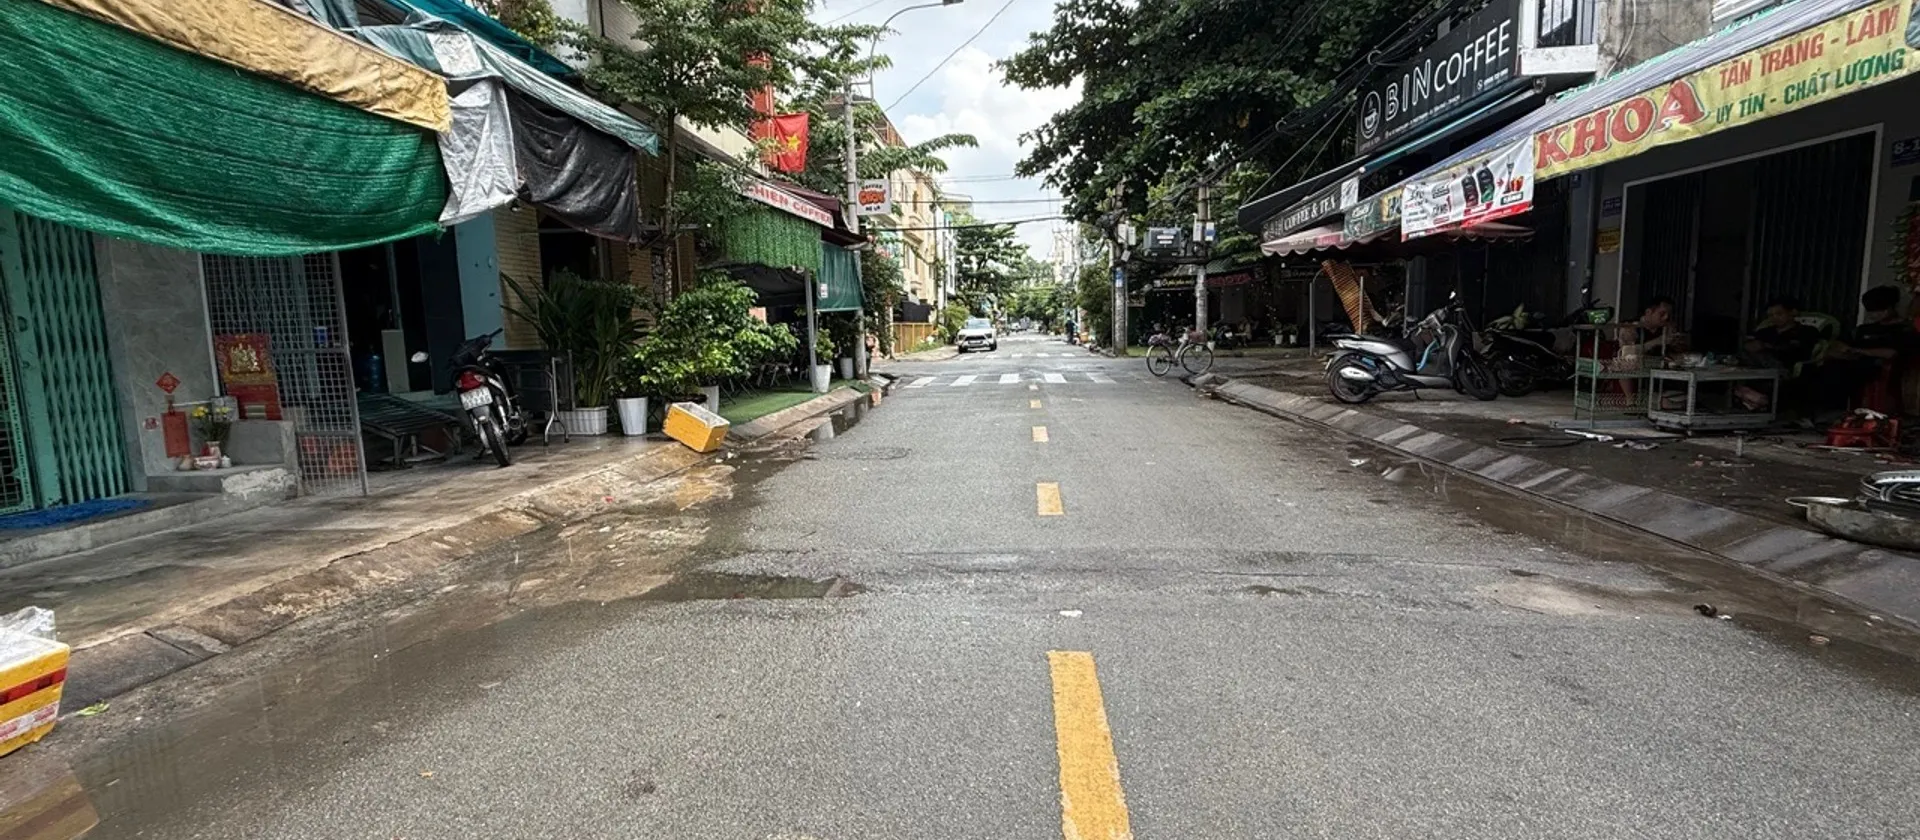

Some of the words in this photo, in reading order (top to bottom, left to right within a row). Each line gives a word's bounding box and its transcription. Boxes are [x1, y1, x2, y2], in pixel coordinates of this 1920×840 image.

[1385, 59, 1431, 122] BIN
[1434, 19, 1511, 92] COFFEE
[1716, 102, 1733, 124] UY
[1739, 93, 1766, 118] TÍN
[1784, 67, 1830, 105] CHẤT
[1835, 48, 1907, 88] LƯỢNG
[1719, 58, 1752, 90] TÂN
[1760, 32, 1825, 76] TRANG
[1846, 4, 1901, 46] LÀM
[1536, 79, 1705, 169] KHOA
[1283, 207, 1311, 231] COFFEE
[1311, 202, 1319, 219] &
[1319, 194, 1337, 214] TEA
